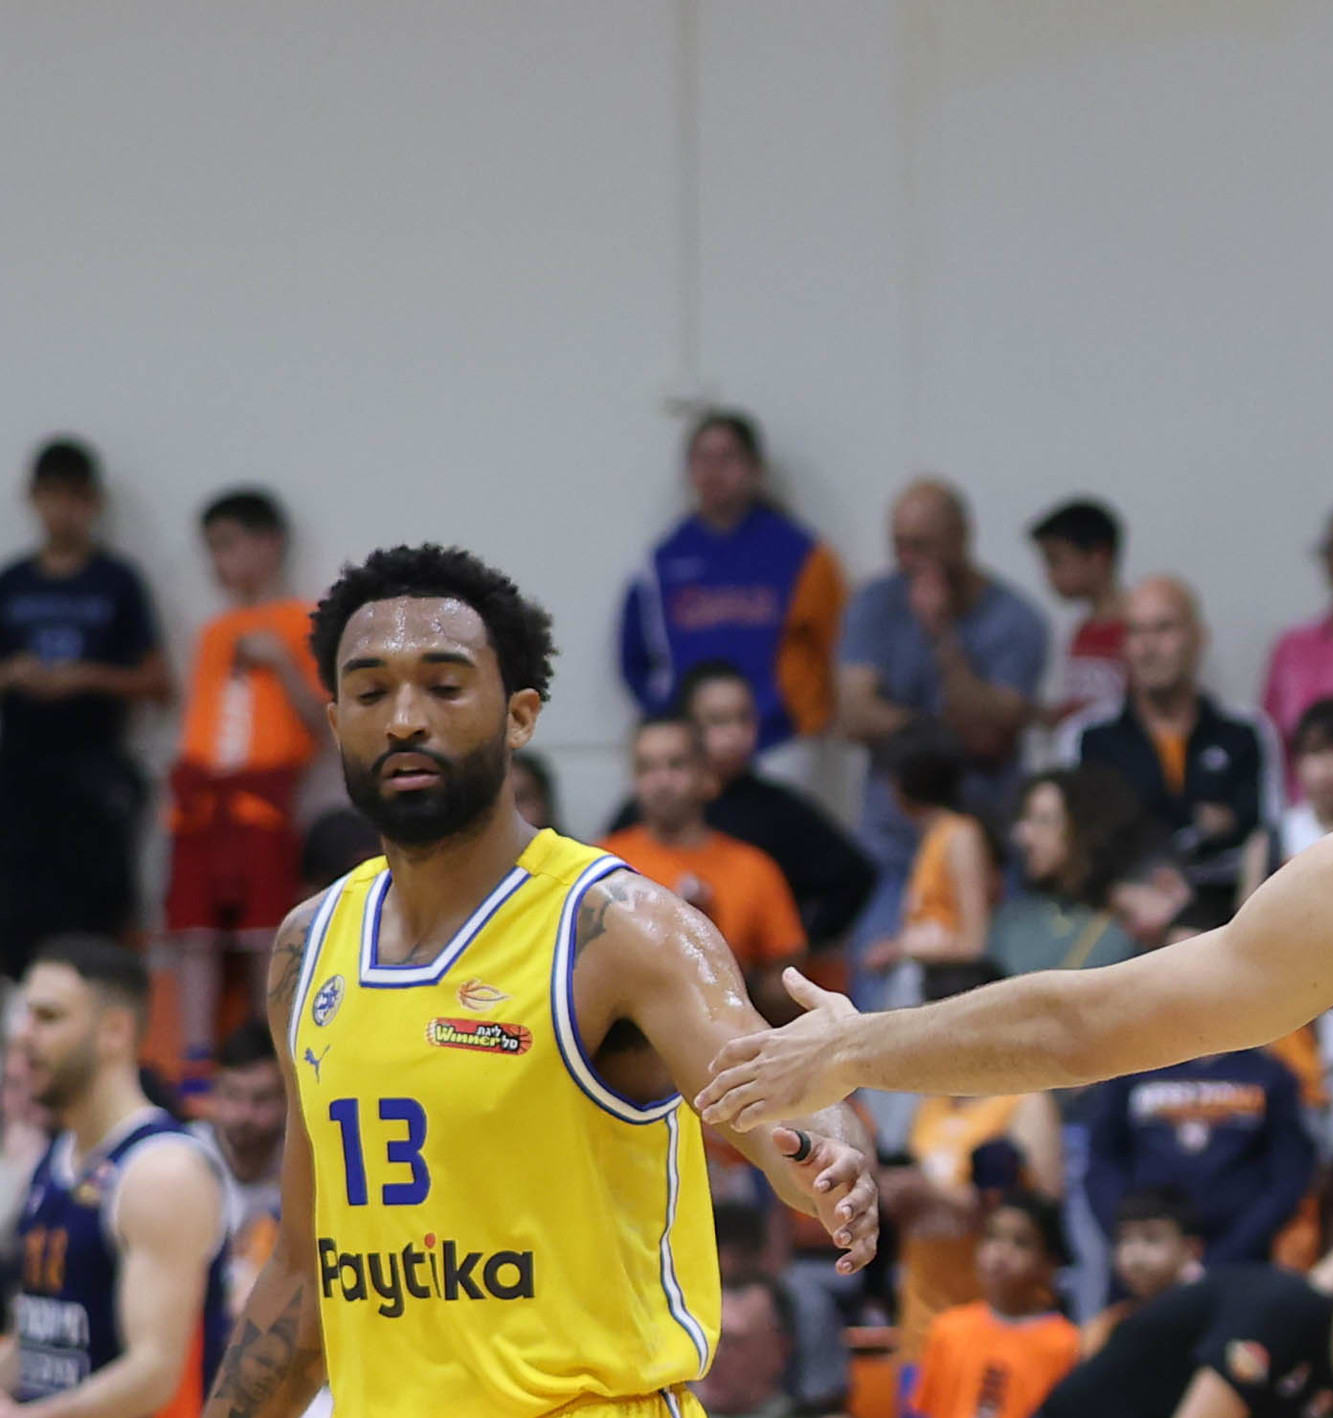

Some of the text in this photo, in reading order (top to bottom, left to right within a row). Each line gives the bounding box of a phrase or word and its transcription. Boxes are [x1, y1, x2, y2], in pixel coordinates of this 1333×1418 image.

[435, 1025, 502, 1047] Winner
[502, 1036, 518, 1050] סל
[329, 1097, 432, 1206] 13
[318, 1232, 535, 1319] Paytika
